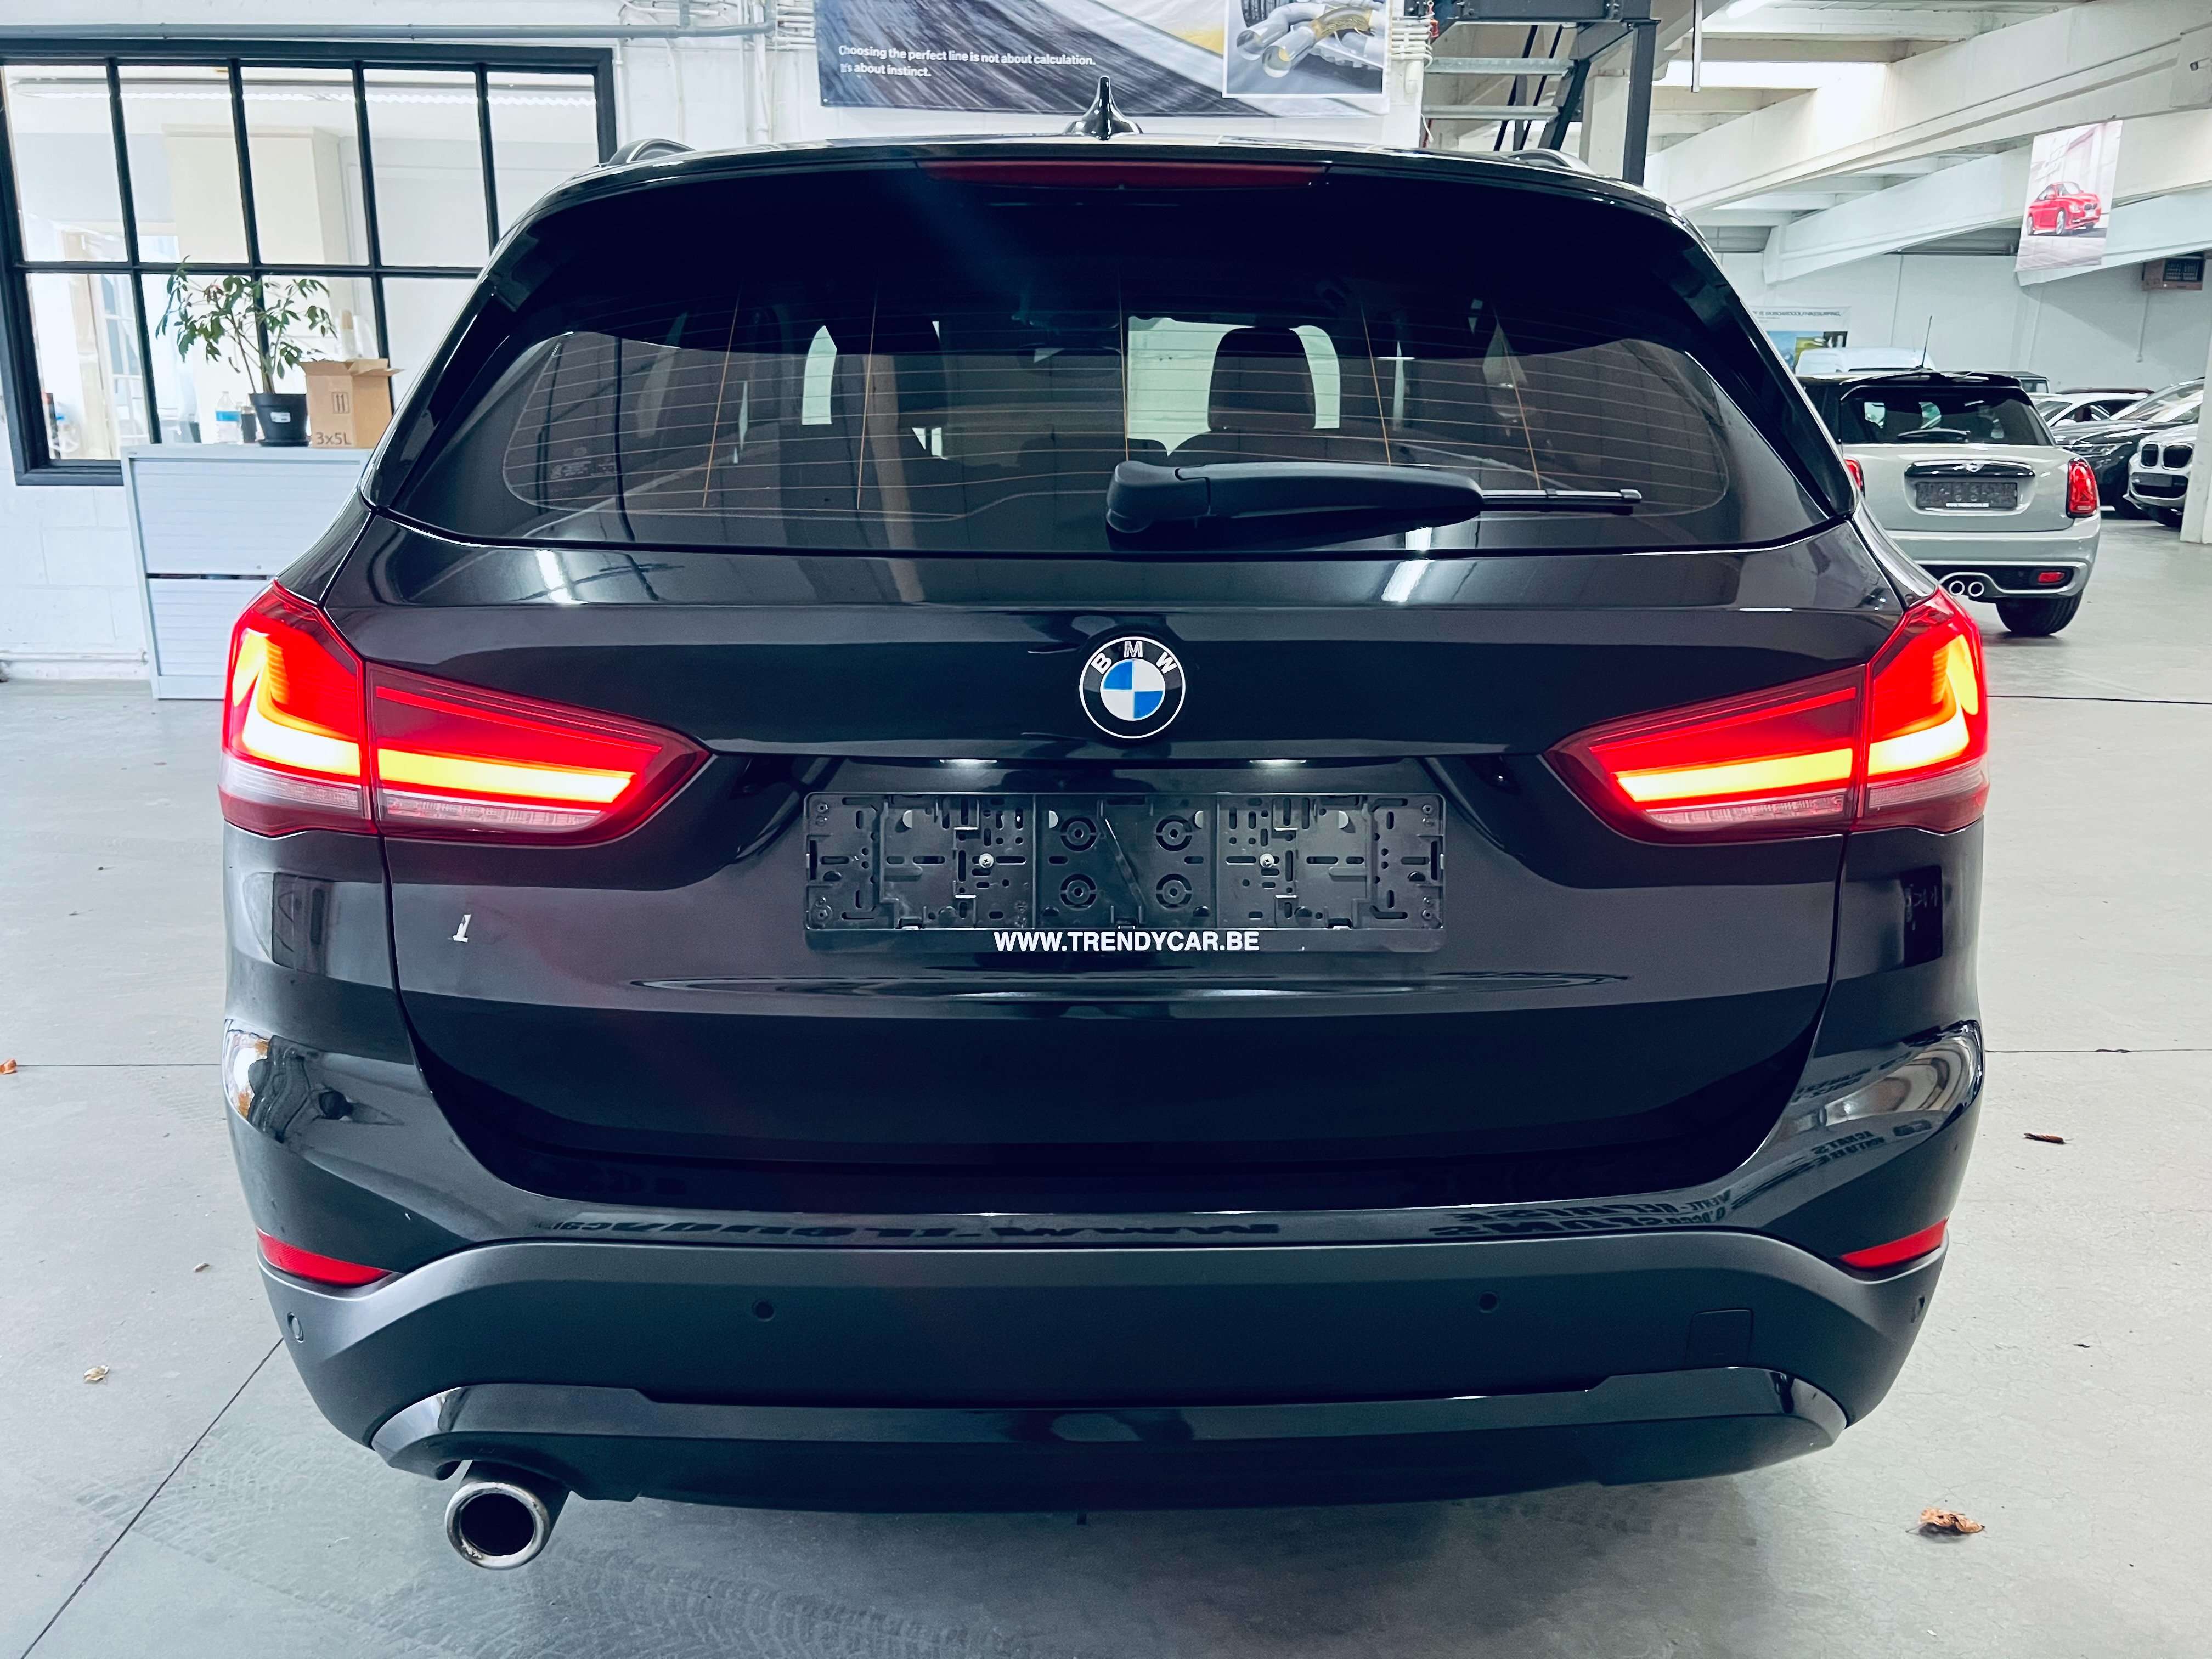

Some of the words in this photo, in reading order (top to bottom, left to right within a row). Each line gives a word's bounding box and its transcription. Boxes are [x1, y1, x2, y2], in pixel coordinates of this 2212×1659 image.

[838, 45, 887, 59] Choosing
[888, 48, 907, 59] the
[908, 50, 947, 61] perfect
[948, 50, 969, 61] line
[969, 52, 980, 62] is
[980, 54, 1000, 63] not
[1001, 53, 1032, 64] about
[1034, 54, 1096, 65] calculation.
[840, 63, 853, 74] It's
[854, 63, 885, 75] about
[887, 65, 932, 77] instinct.
[315, 432, 352, 445] 3x5L
[1091, 640, 1177, 675] BMW
[993, 931, 1260, 952] WWW.TRENDYCAR.BE
